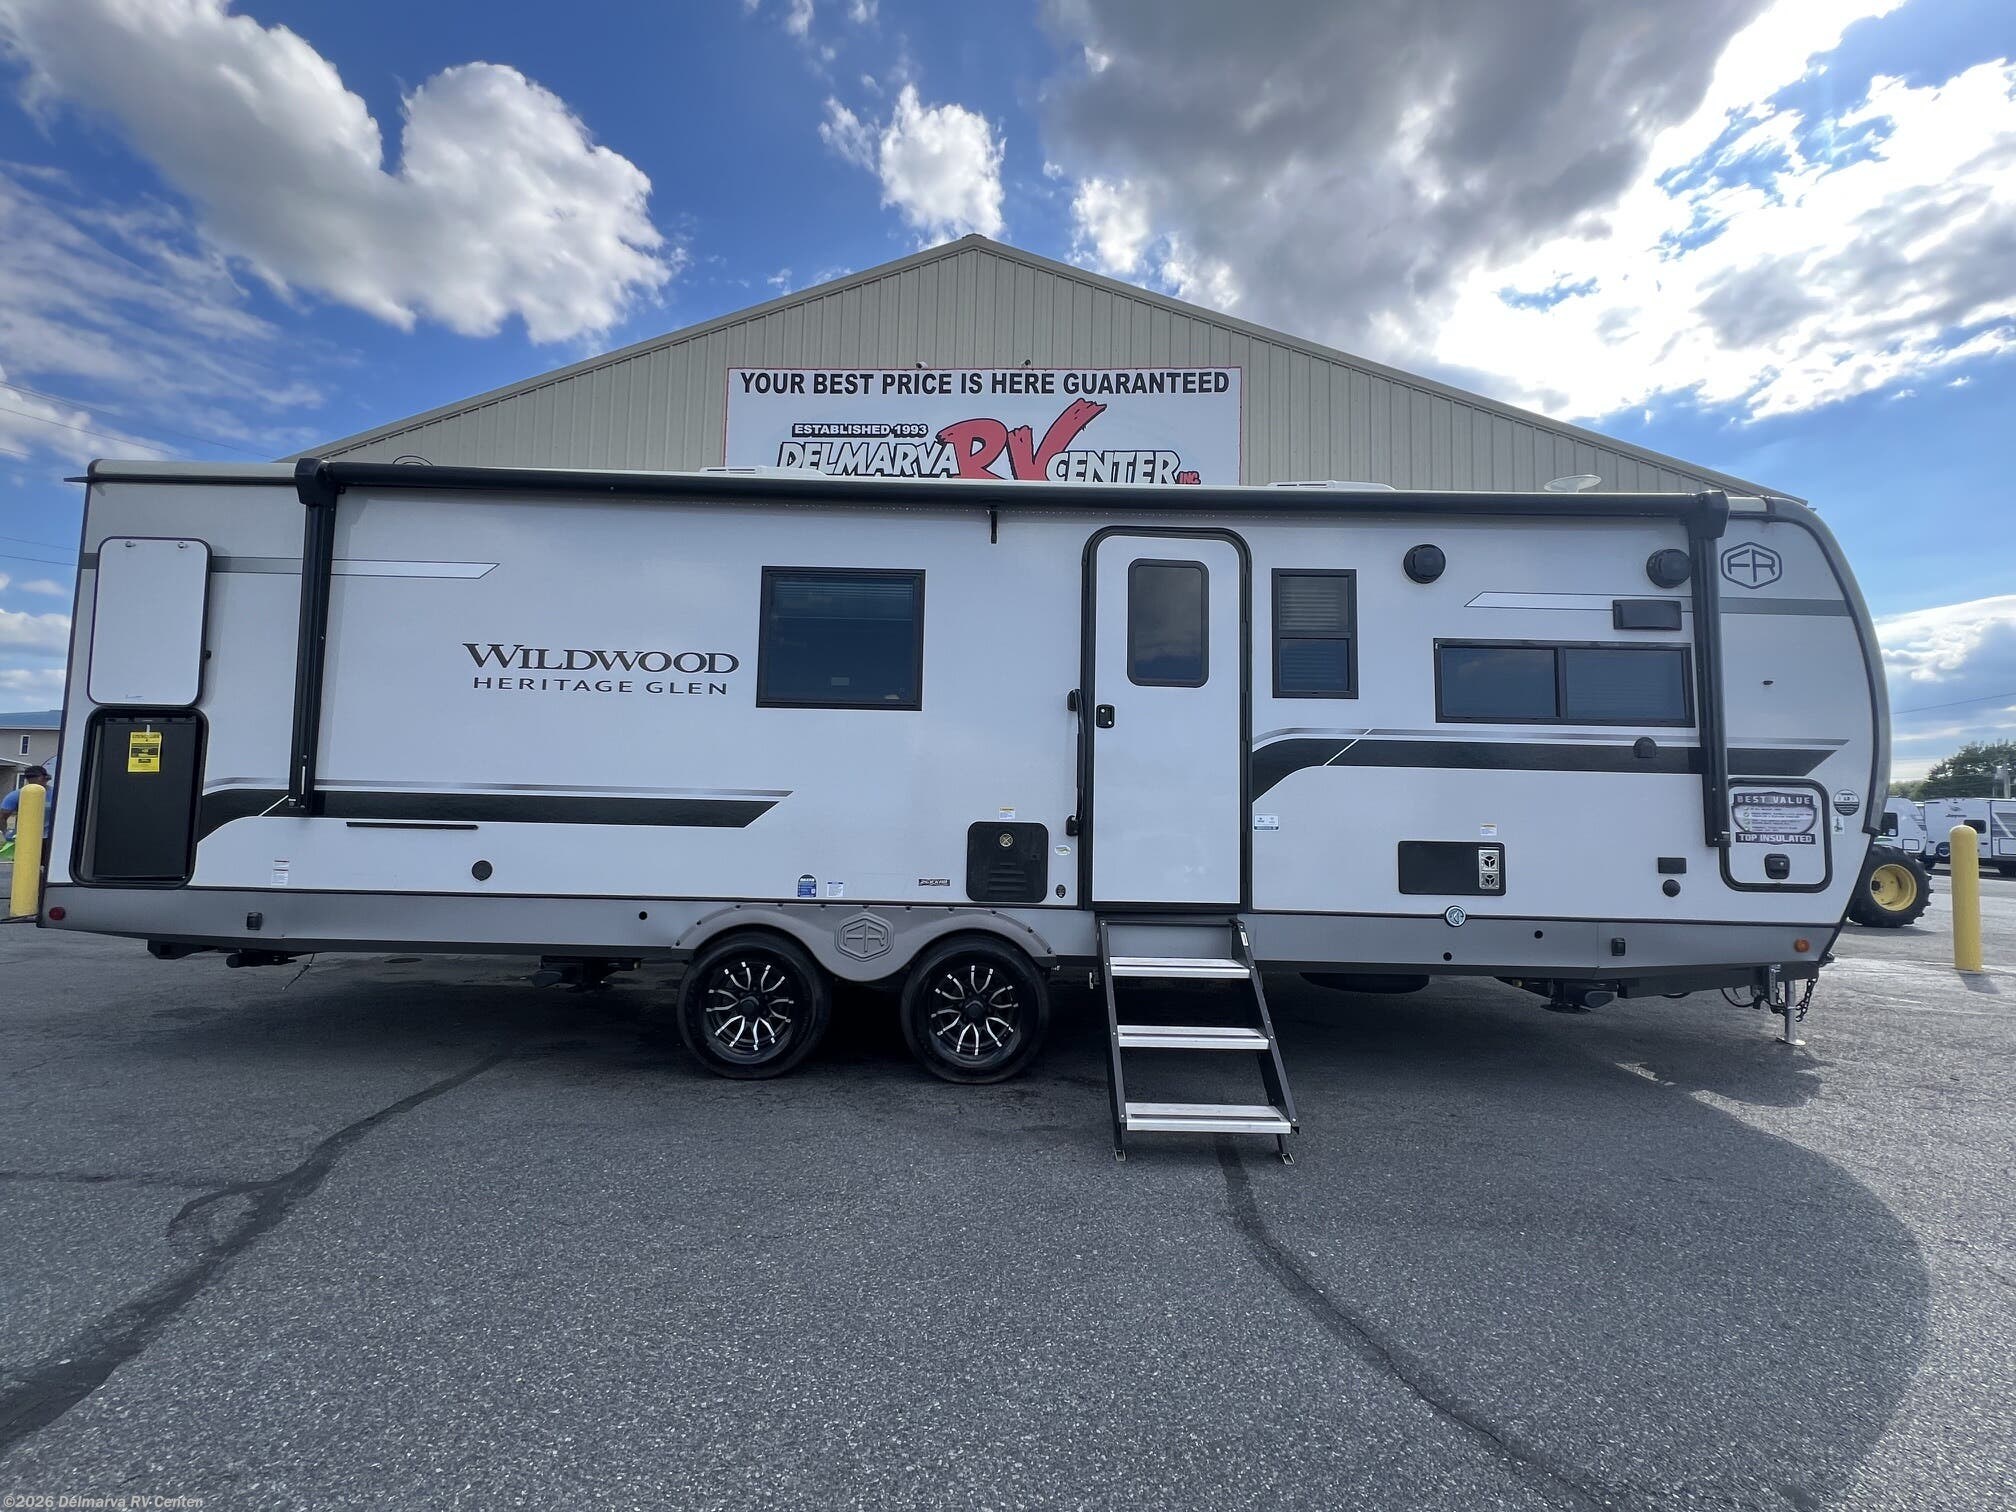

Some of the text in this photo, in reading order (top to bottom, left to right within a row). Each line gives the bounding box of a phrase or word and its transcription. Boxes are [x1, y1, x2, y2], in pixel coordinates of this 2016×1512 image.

[740, 371, 1230, 395] YOUR BEST PRICE IS HERE GUARANTEED
[793, 423, 929, 436] ESTABLISHED 1993
[777, 441, 961, 478] DELMARVA
[935, 397, 1107, 481] RV
[1045, 450, 1181, 484] CENTER
[473, 677, 728, 695] HERITAGE GLEN
[1736, 795, 1811, 804] BEST VALUE
[1739, 834, 1813, 844] TOP INSULATED
